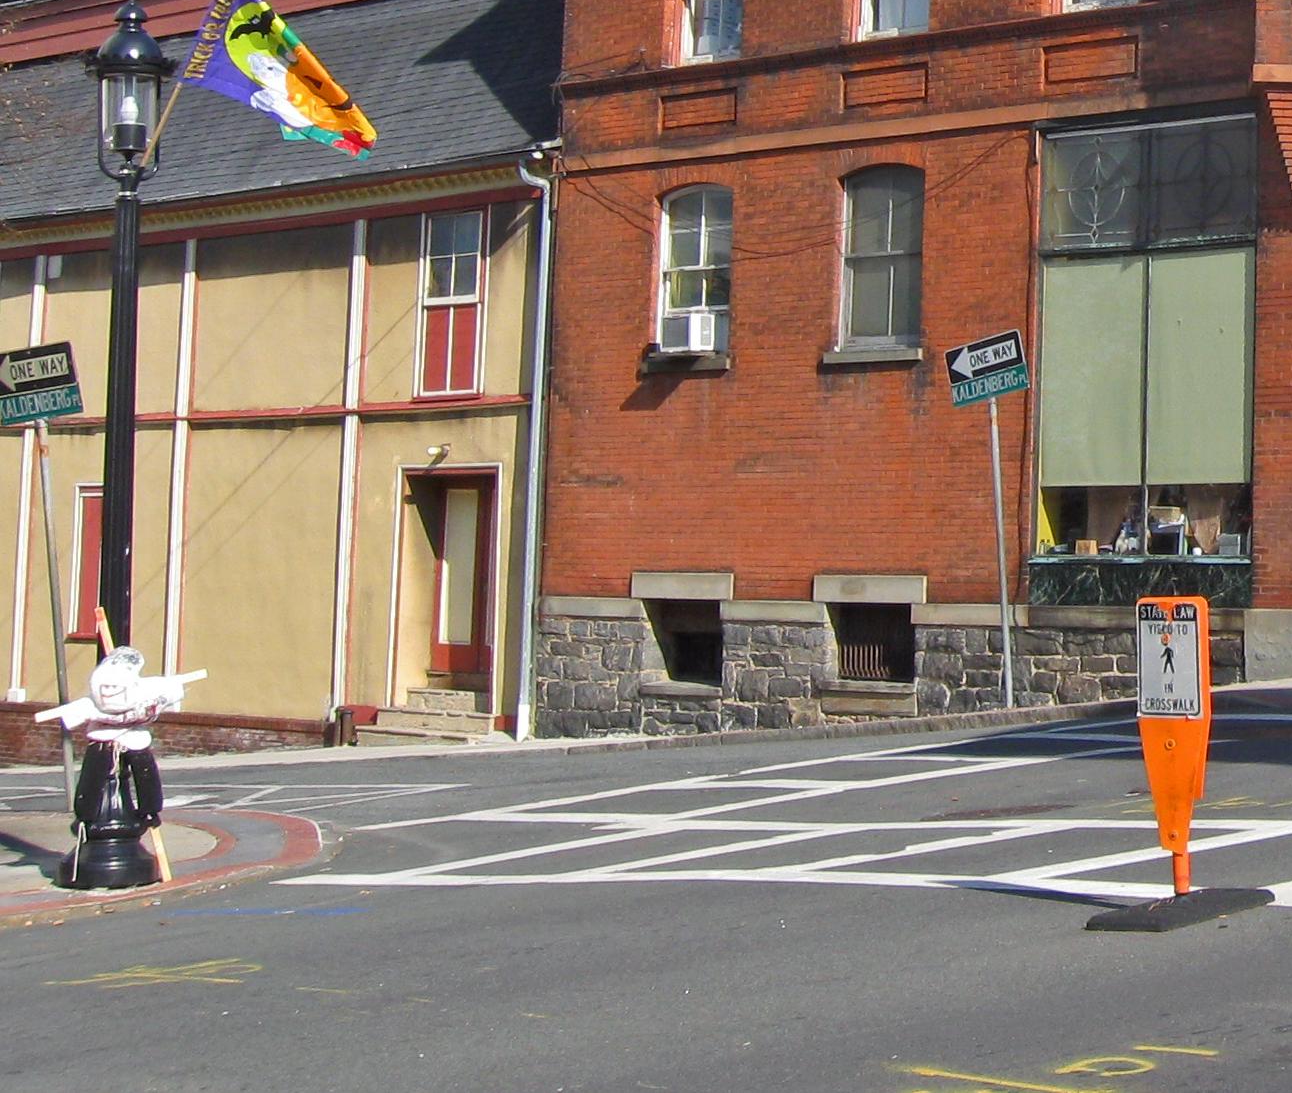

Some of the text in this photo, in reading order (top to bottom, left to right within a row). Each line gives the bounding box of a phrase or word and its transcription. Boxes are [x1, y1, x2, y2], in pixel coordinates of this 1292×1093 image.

[184, 41, 216, 79] TRICK
[969, 342, 1014, 368] ONE WAY
[10, 355, 66, 381] ONE WAY
[952, 370, 1018, 404] KALDENBERG
[1173, 605, 1195, 619] LAW
[1176, 623, 1188, 636] TO
[1164, 682, 1174, 694] IN
[1144, 698, 1196, 712] CROSSWALK
